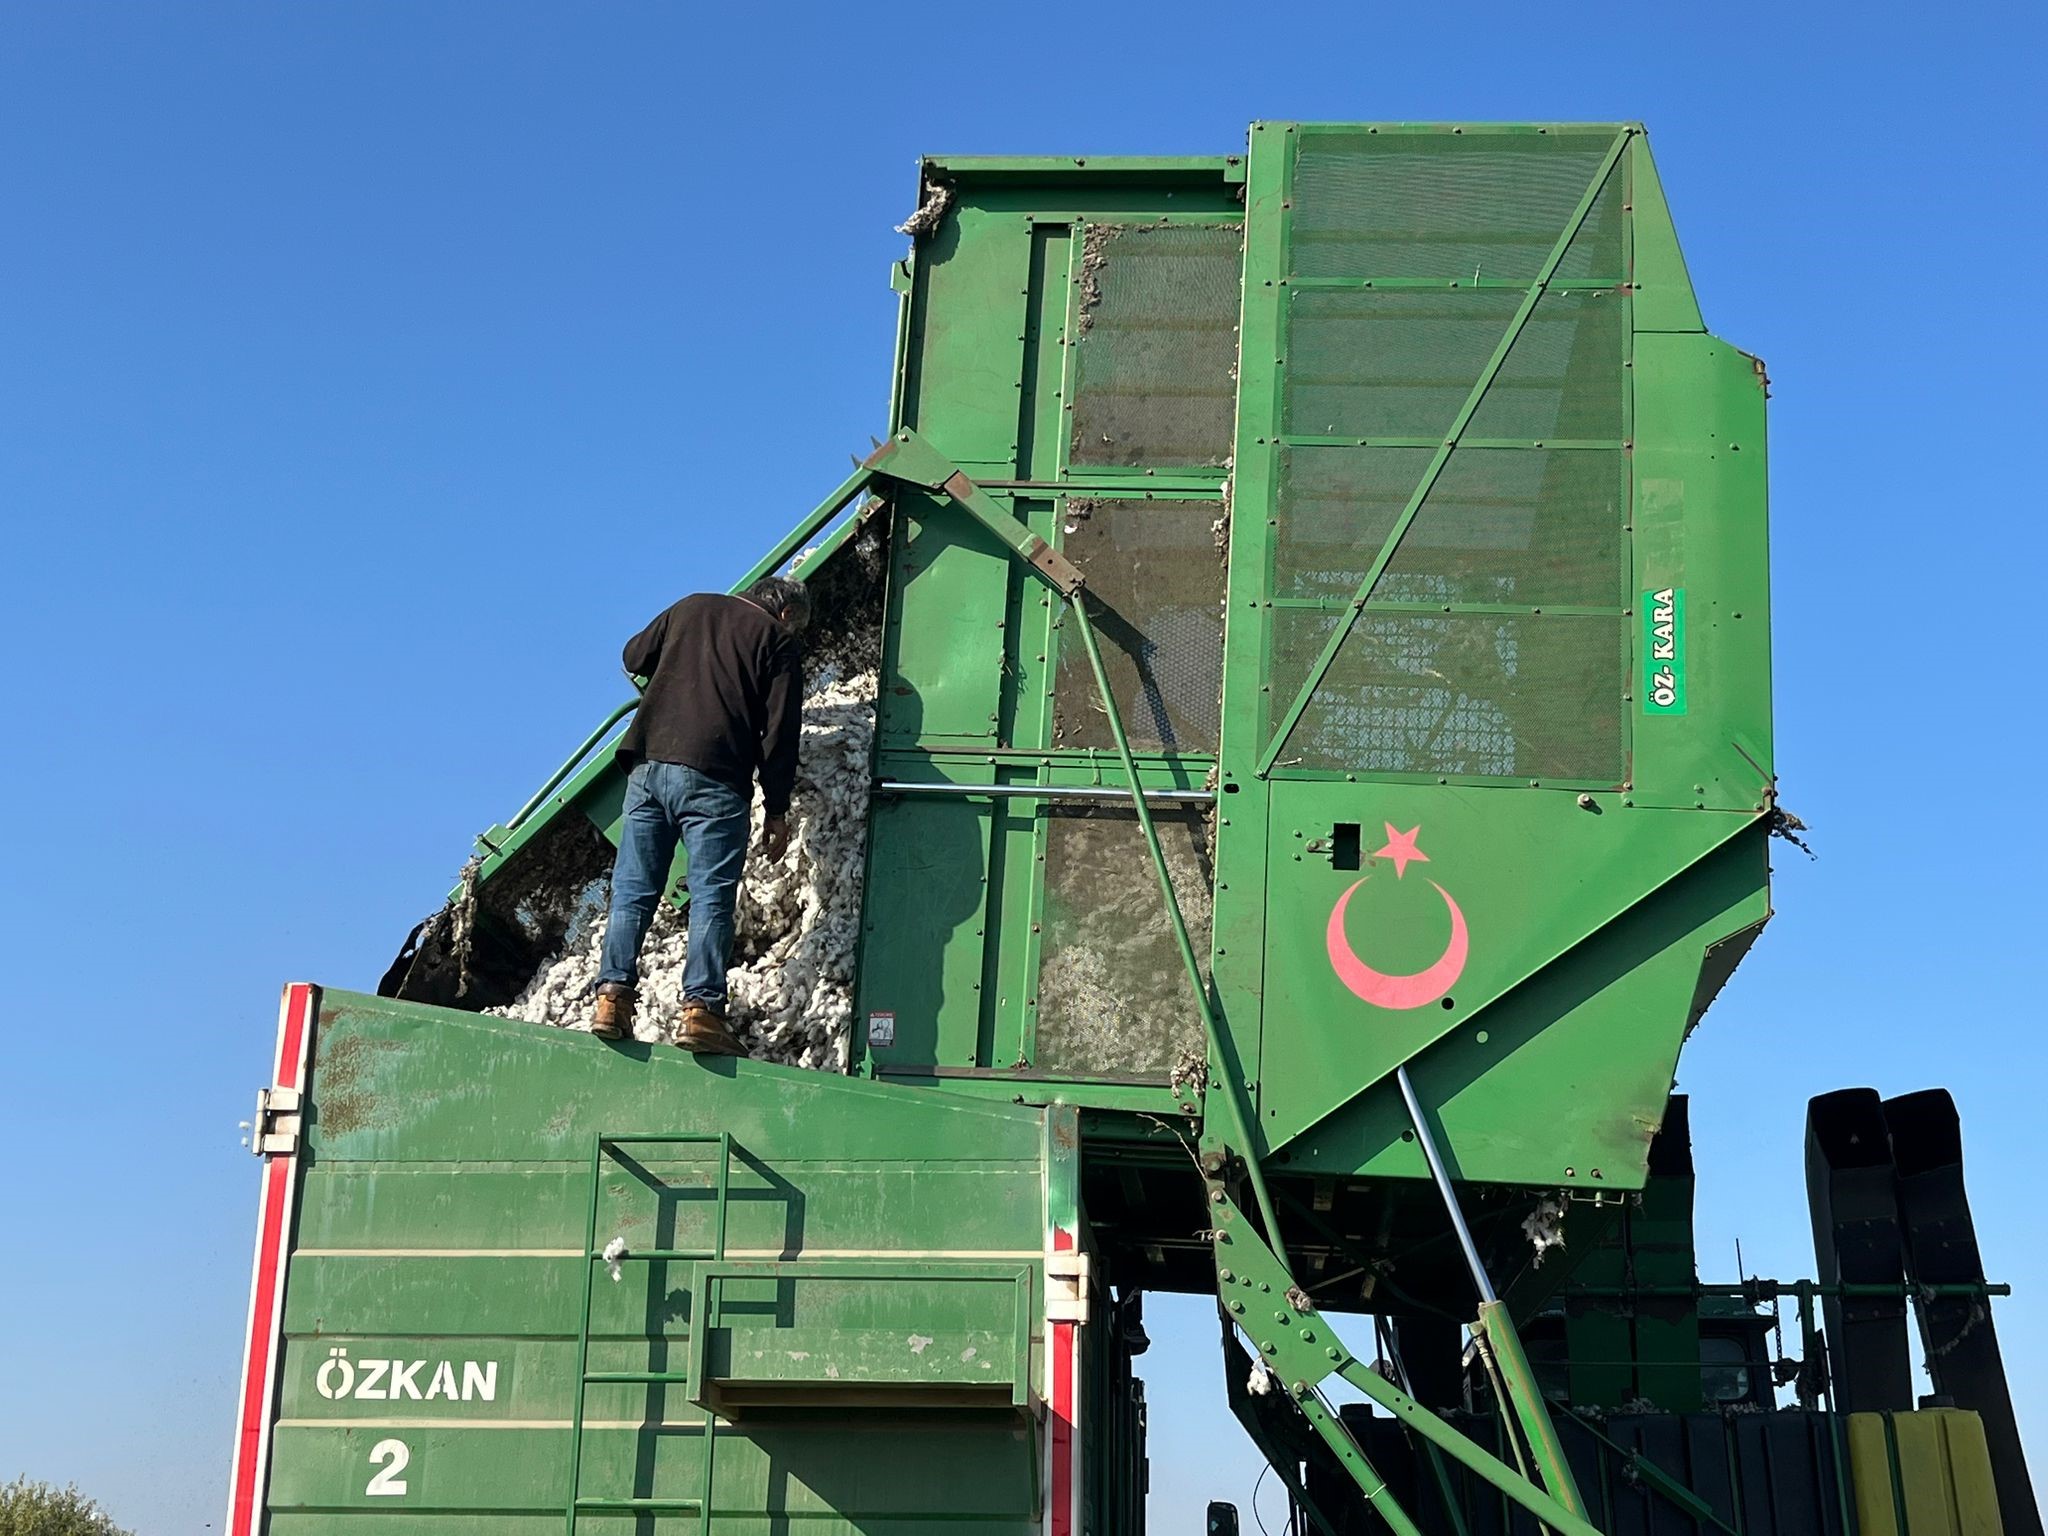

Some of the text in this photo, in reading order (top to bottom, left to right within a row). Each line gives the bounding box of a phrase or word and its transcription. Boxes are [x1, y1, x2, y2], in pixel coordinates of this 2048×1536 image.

[1649, 587, 1676, 706] ÖZ- KARA
[316, 1348, 498, 1401] ÖZKAN
[365, 1438, 410, 1496] 2
